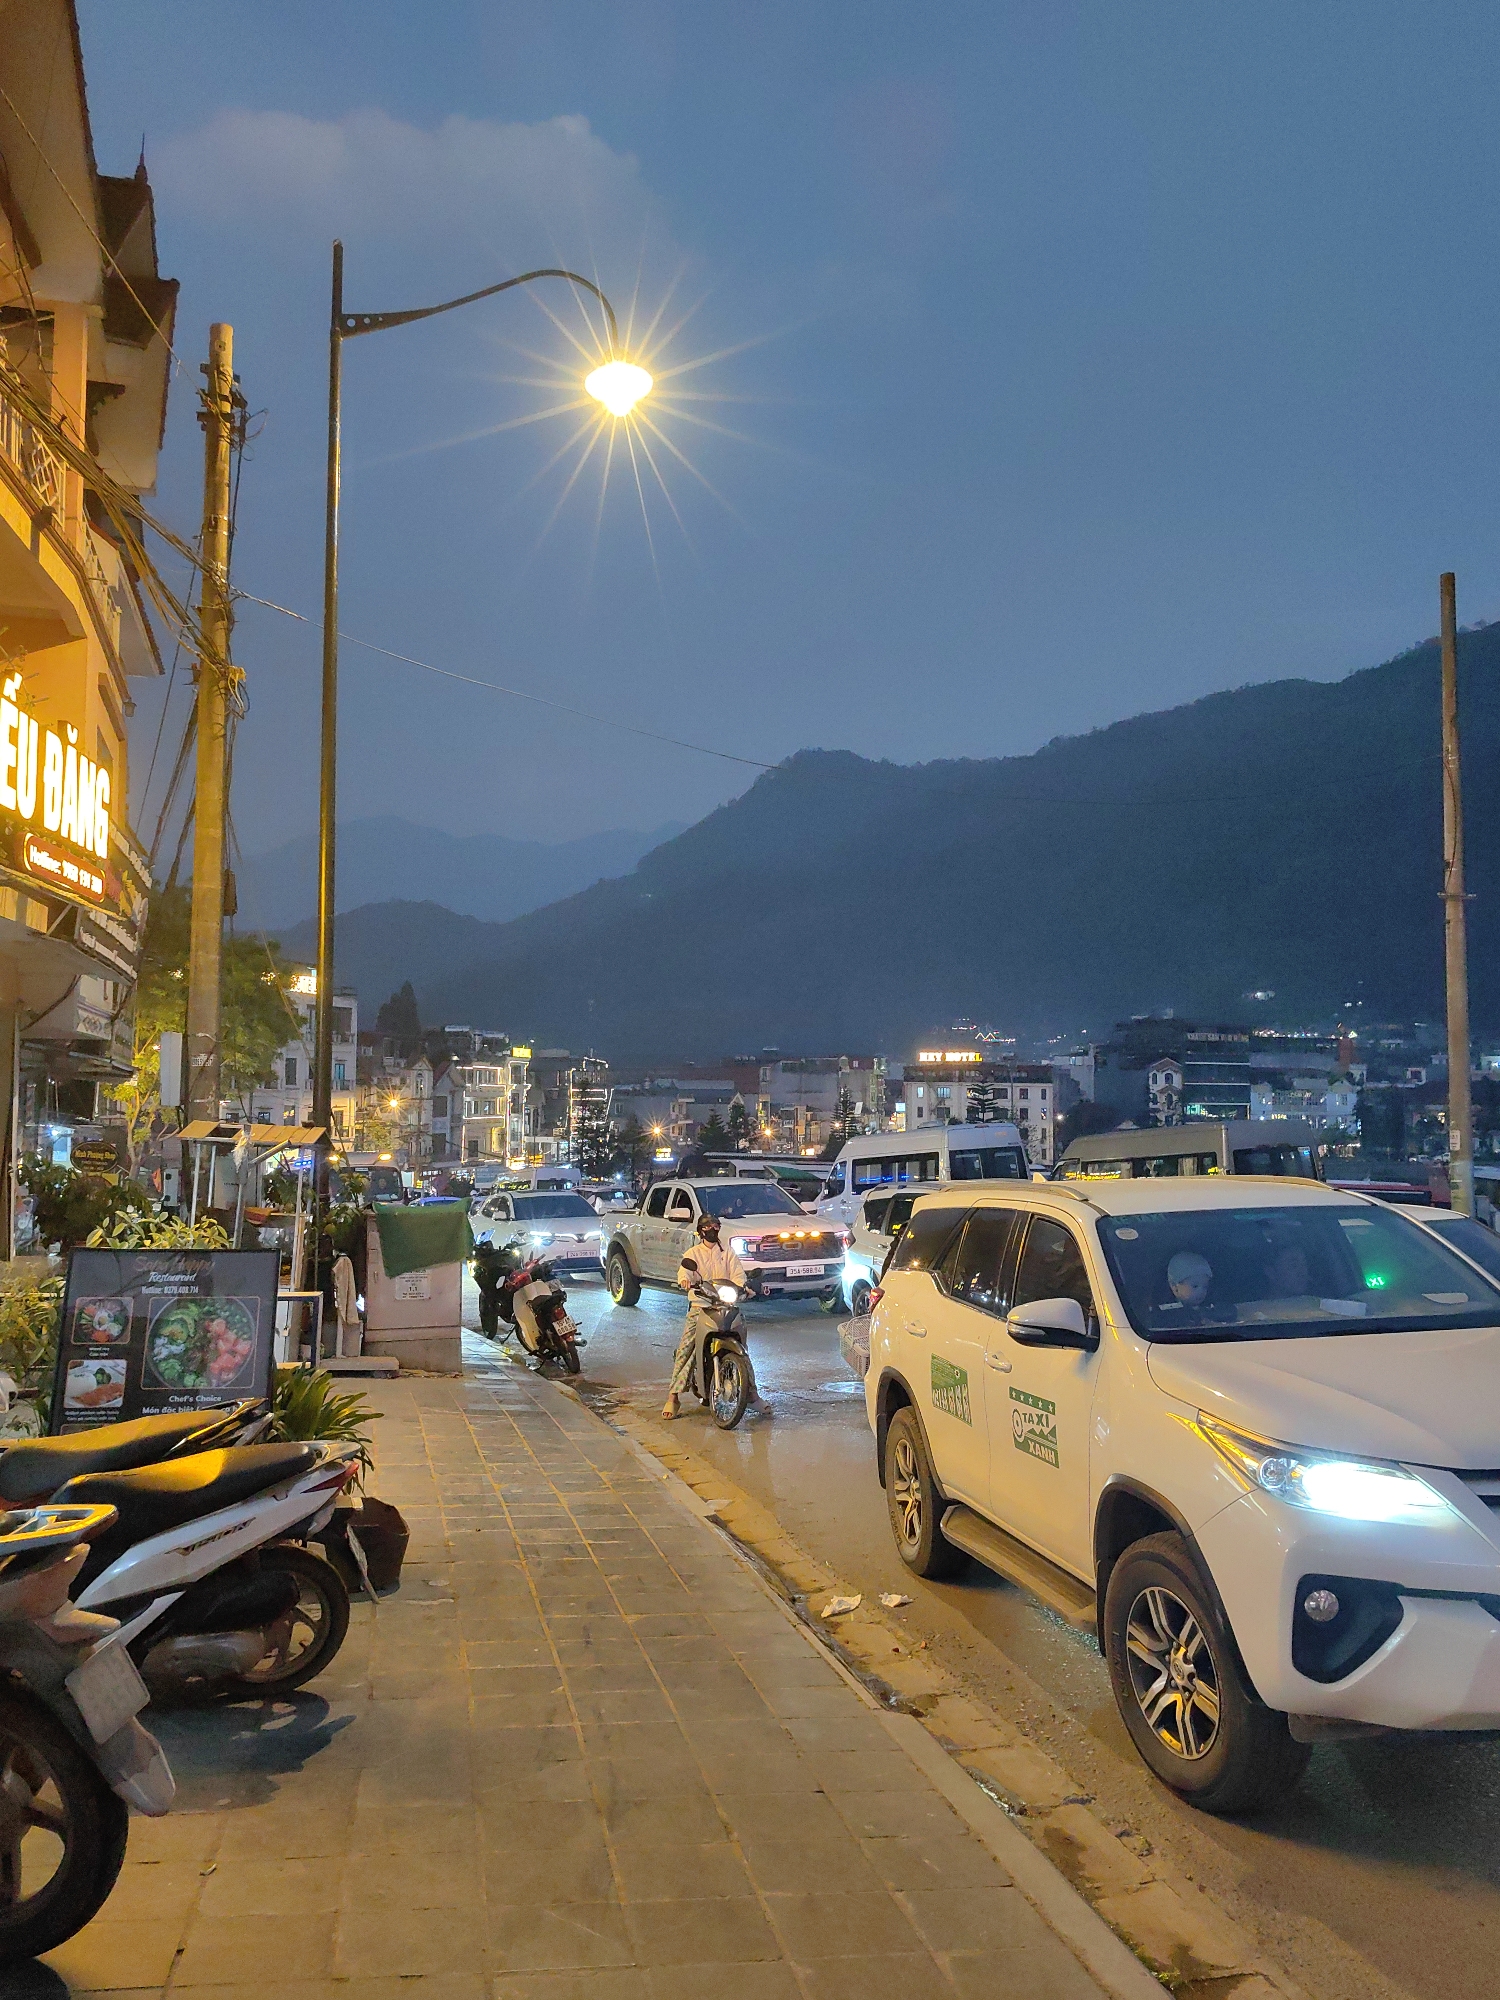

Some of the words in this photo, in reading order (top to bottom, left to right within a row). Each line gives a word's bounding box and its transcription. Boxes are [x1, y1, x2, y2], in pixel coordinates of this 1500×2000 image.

[43, 723, 110, 859] ĐĂNG
[944, 1052, 983, 1062] HOTEL
[149, 1271, 197, 1282] Restaurant
[168, 1395, 194, 1403] Chef's
[1022, 1413, 1049, 1428] TAXI
[1028, 1440, 1056, 1464] XANH
